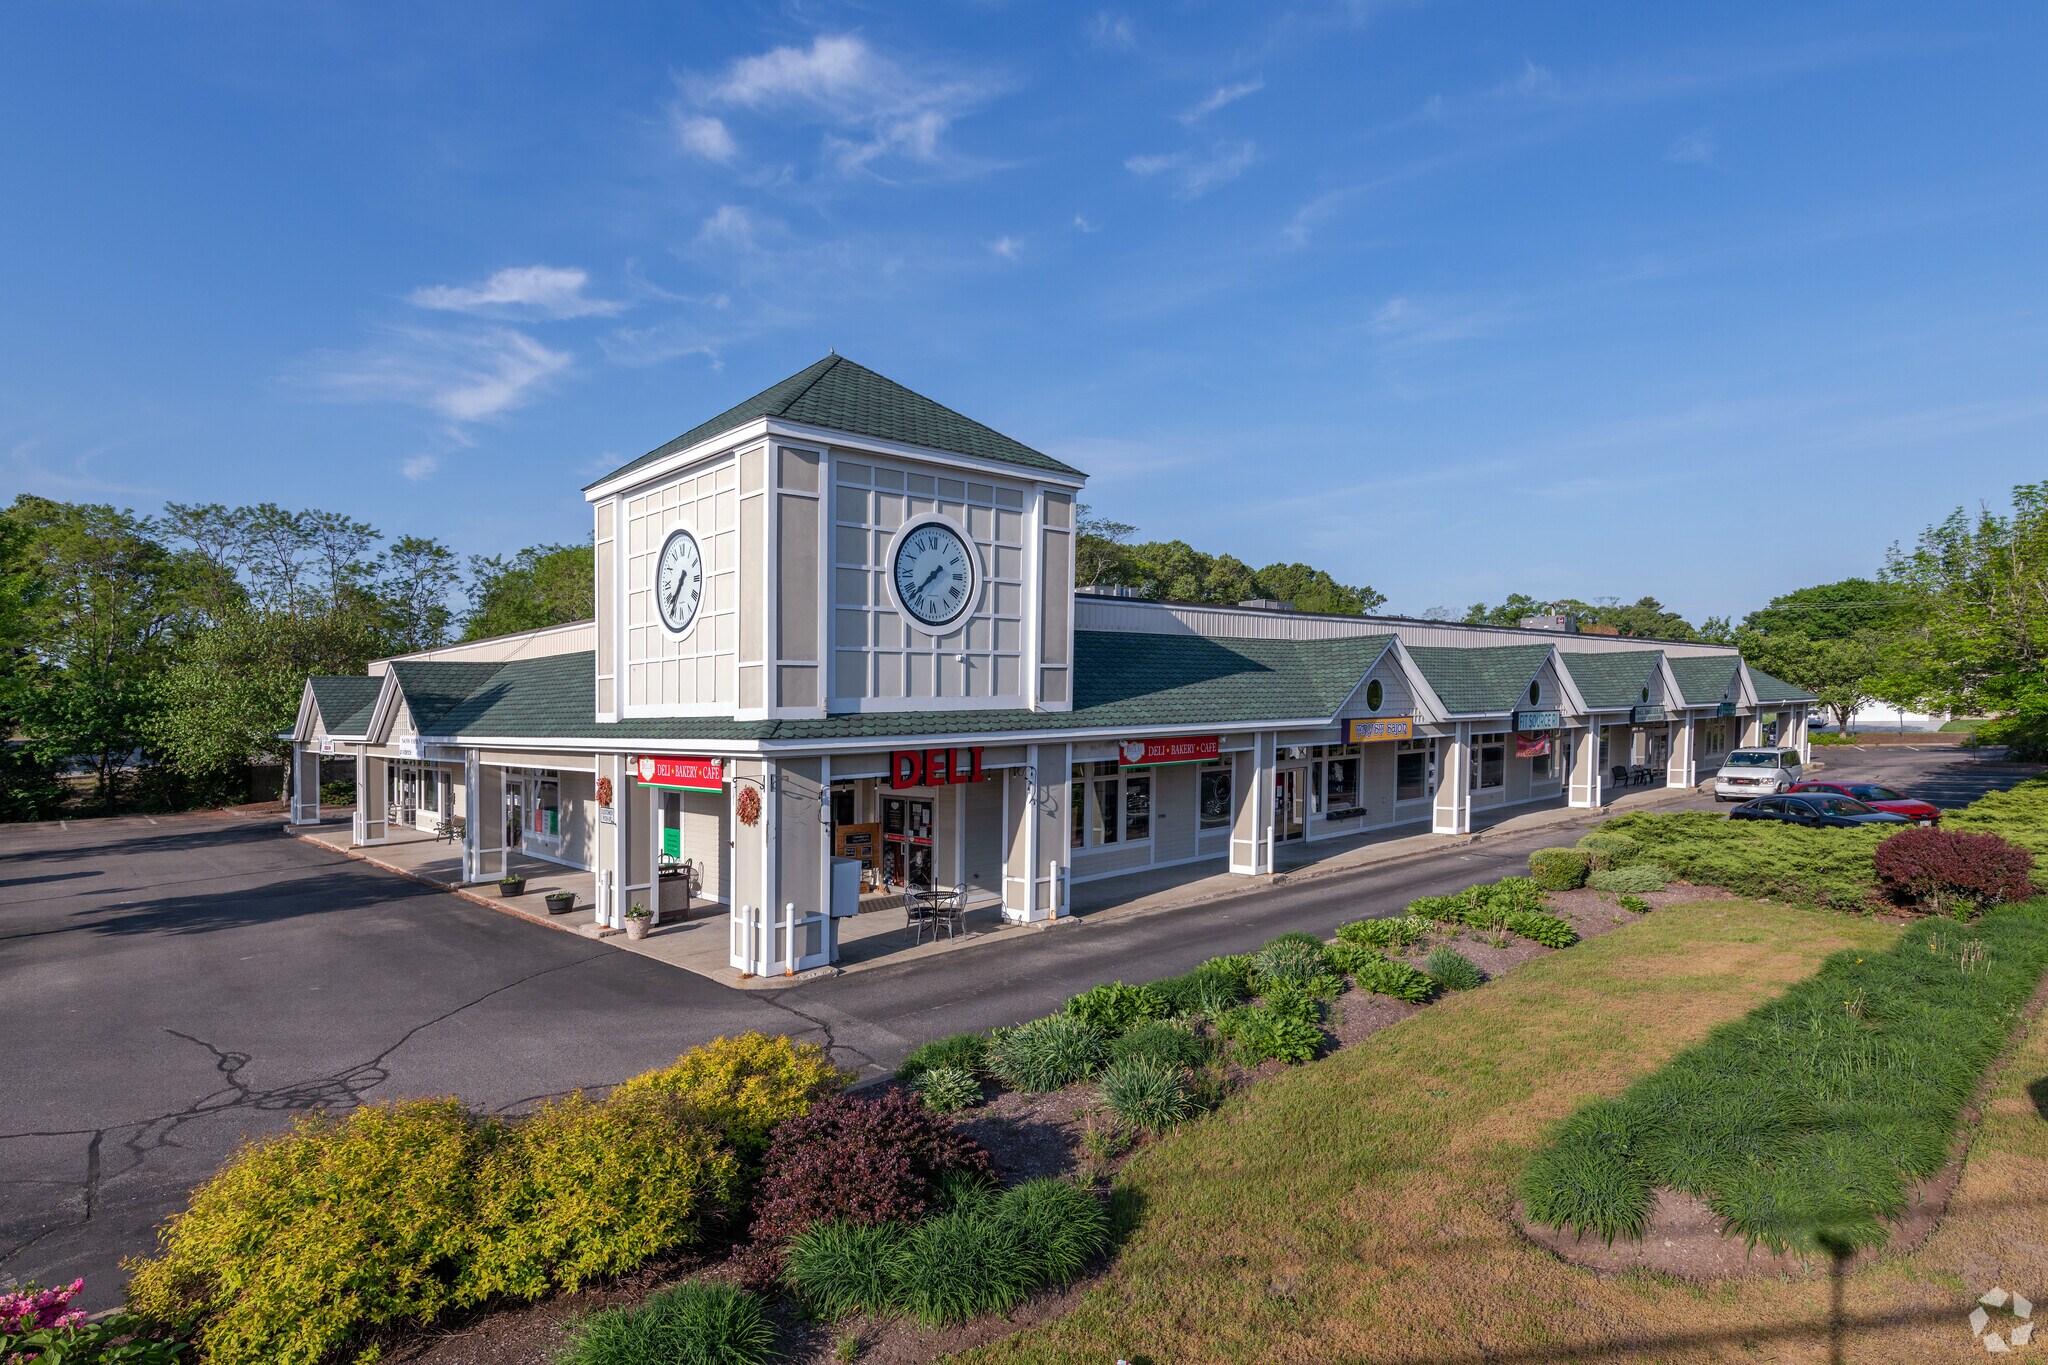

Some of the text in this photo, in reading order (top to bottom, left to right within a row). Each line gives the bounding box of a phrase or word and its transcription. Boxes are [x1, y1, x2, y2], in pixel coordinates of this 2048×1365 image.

[915, 539, 926, 554] XI
[929, 536, 938, 550] XII
[905, 551, 917, 564] X
[949, 557, 960, 565] II
[902, 568, 913, 577] IX
[952, 573, 963, 581] III
[929, 600, 937, 614] VI
[942, 598, 950, 610] V
[1529, 713, 1551, 728] SOURCE
[1148, 745, 1165, 757] DELI
[1171, 743, 1196, 755] BAKERY
[657, 764, 671, 777] DELI
[675, 765, 698, 779] BAKERY
[891, 746, 984, 790] DELI
